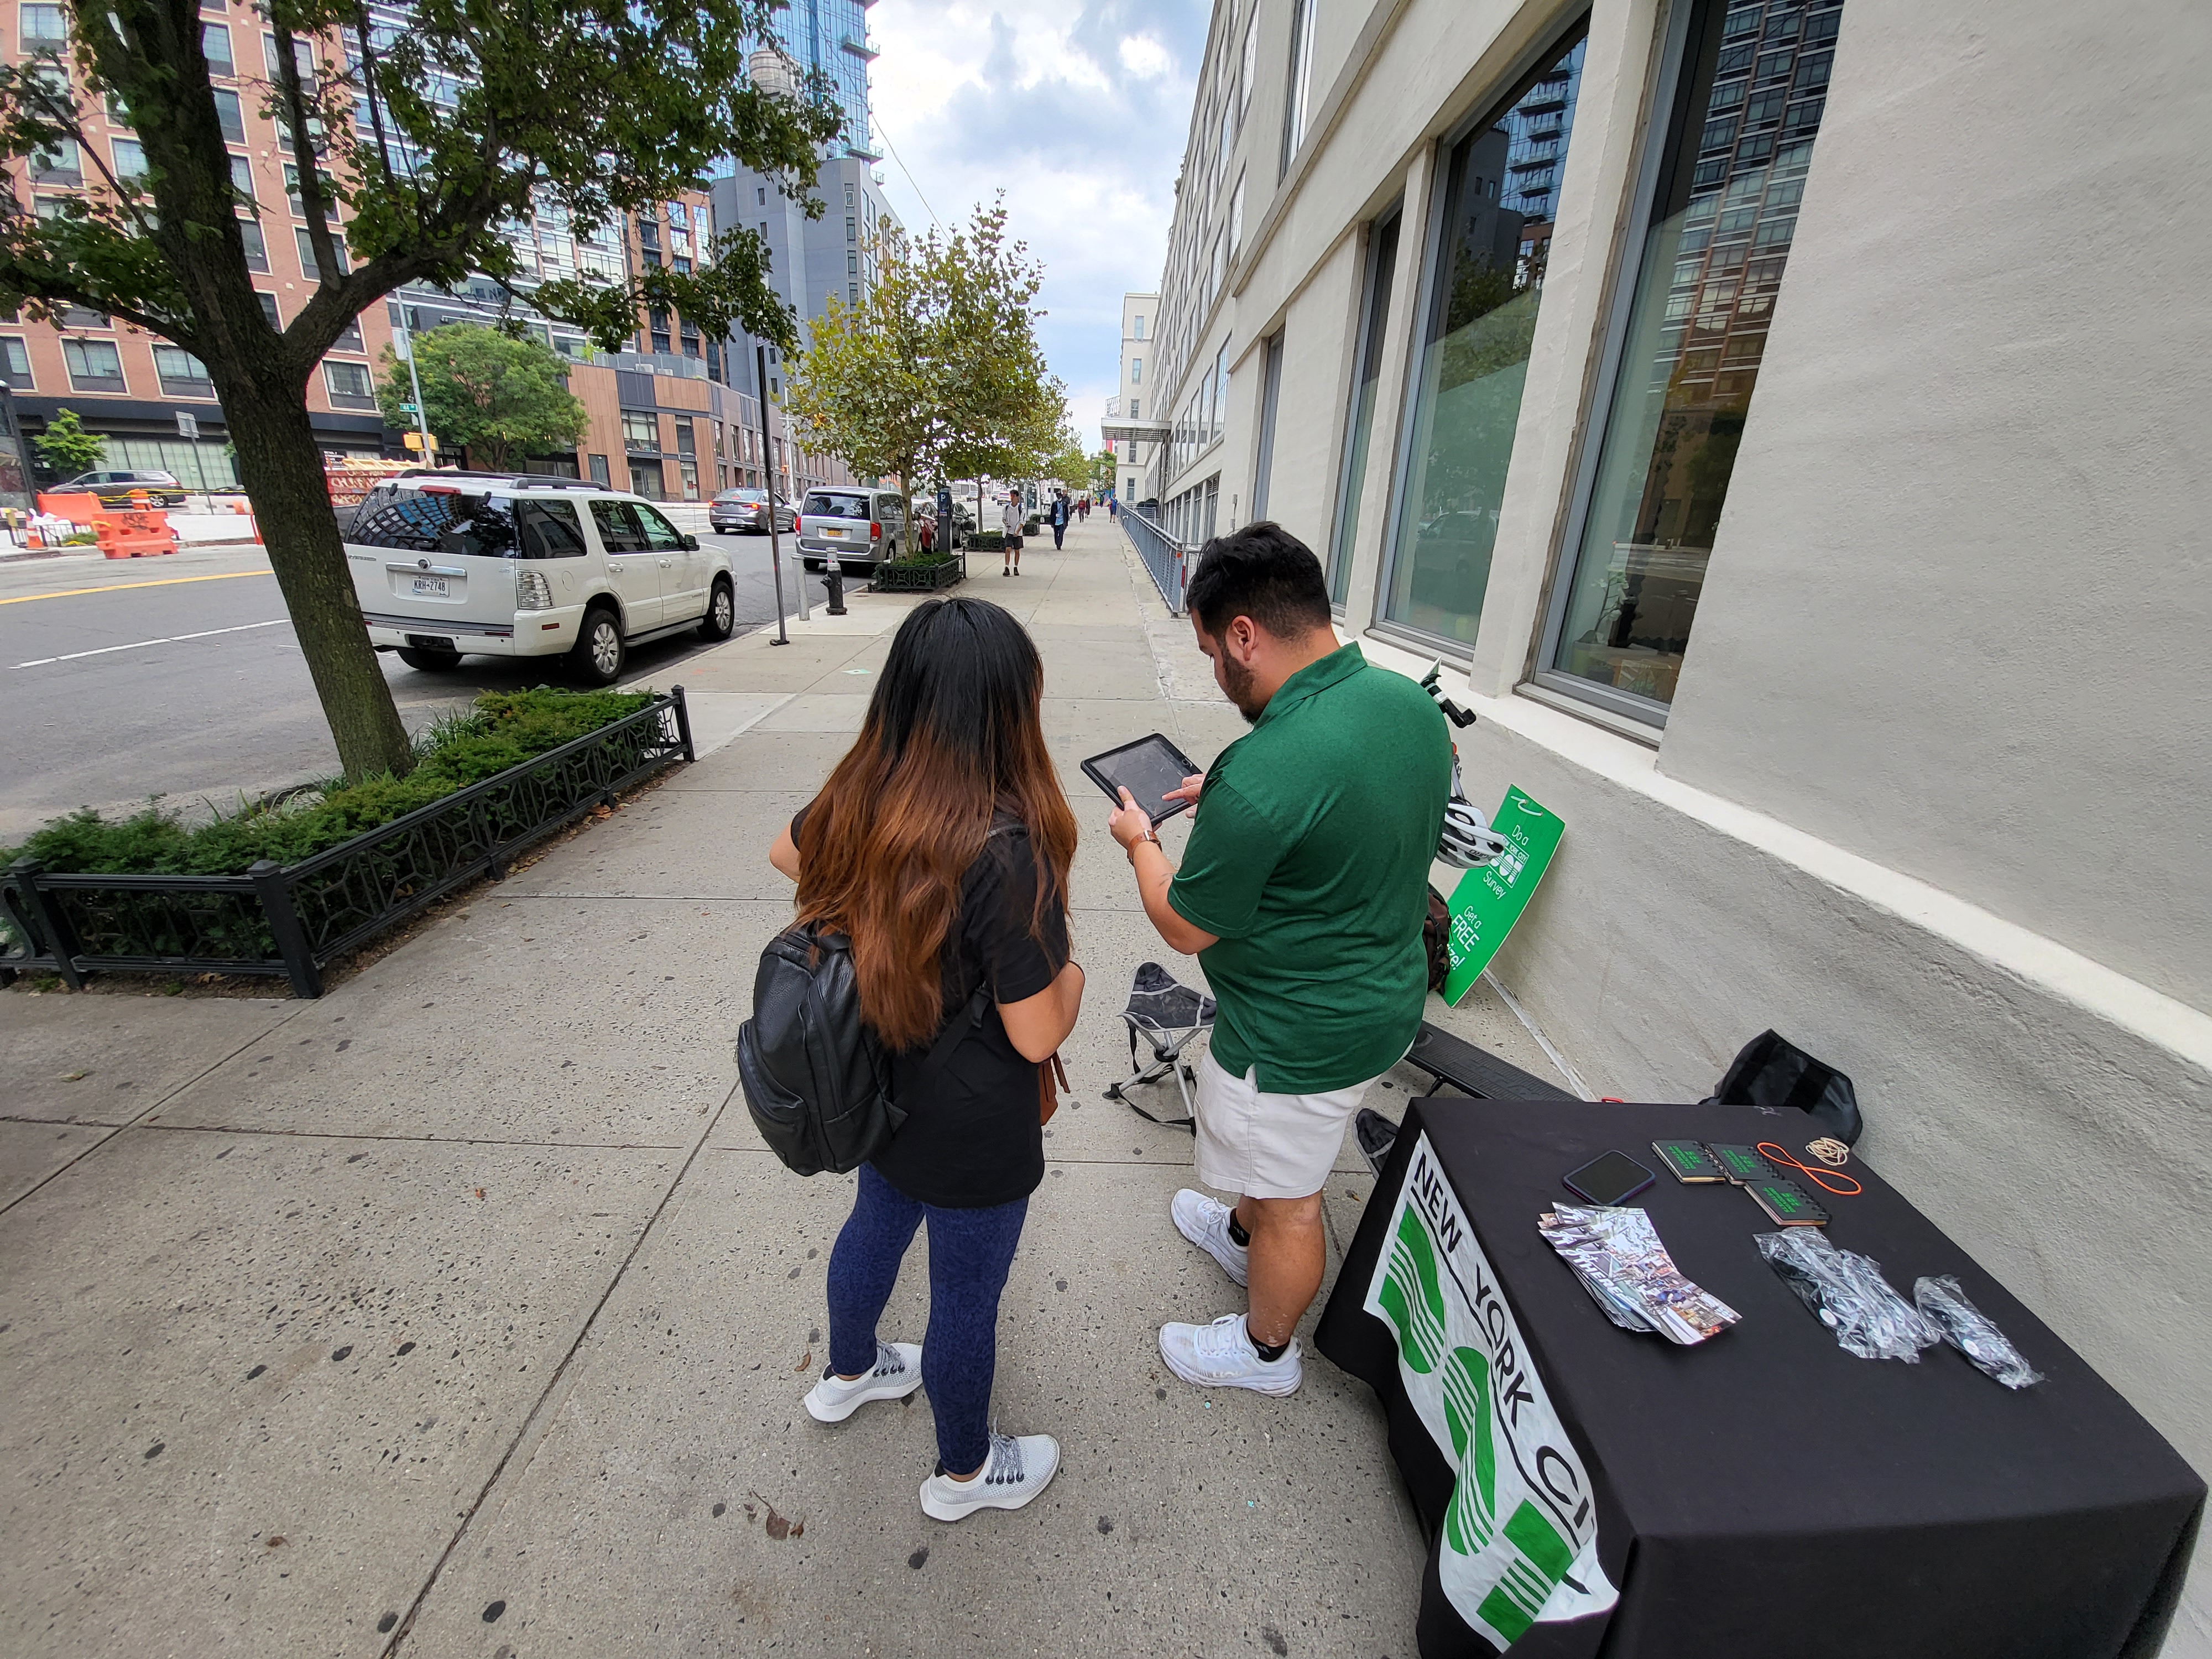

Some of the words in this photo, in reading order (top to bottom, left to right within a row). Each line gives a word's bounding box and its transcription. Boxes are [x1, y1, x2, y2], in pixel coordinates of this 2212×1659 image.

[941, 494, 946, 502] P
[414, 580, 426, 590] KRH
[430, 581, 446, 592] 2748
[1511, 825, 1520, 841] Do
[1521, 837, 1529, 847] a
[1509, 844, 1519, 855] YORK
[1517, 852, 1527, 863] CITY
[1483, 870, 1506, 900] Survey
[1464, 905, 1478, 925] Get
[1474, 920, 1482, 930] a
[1452, 914, 1480, 952] FREE
[1573, 1256, 1624, 1295] THERE
[1414, 1152, 1463, 1254] NEW
[1475, 1261, 1535, 1431] YORK
